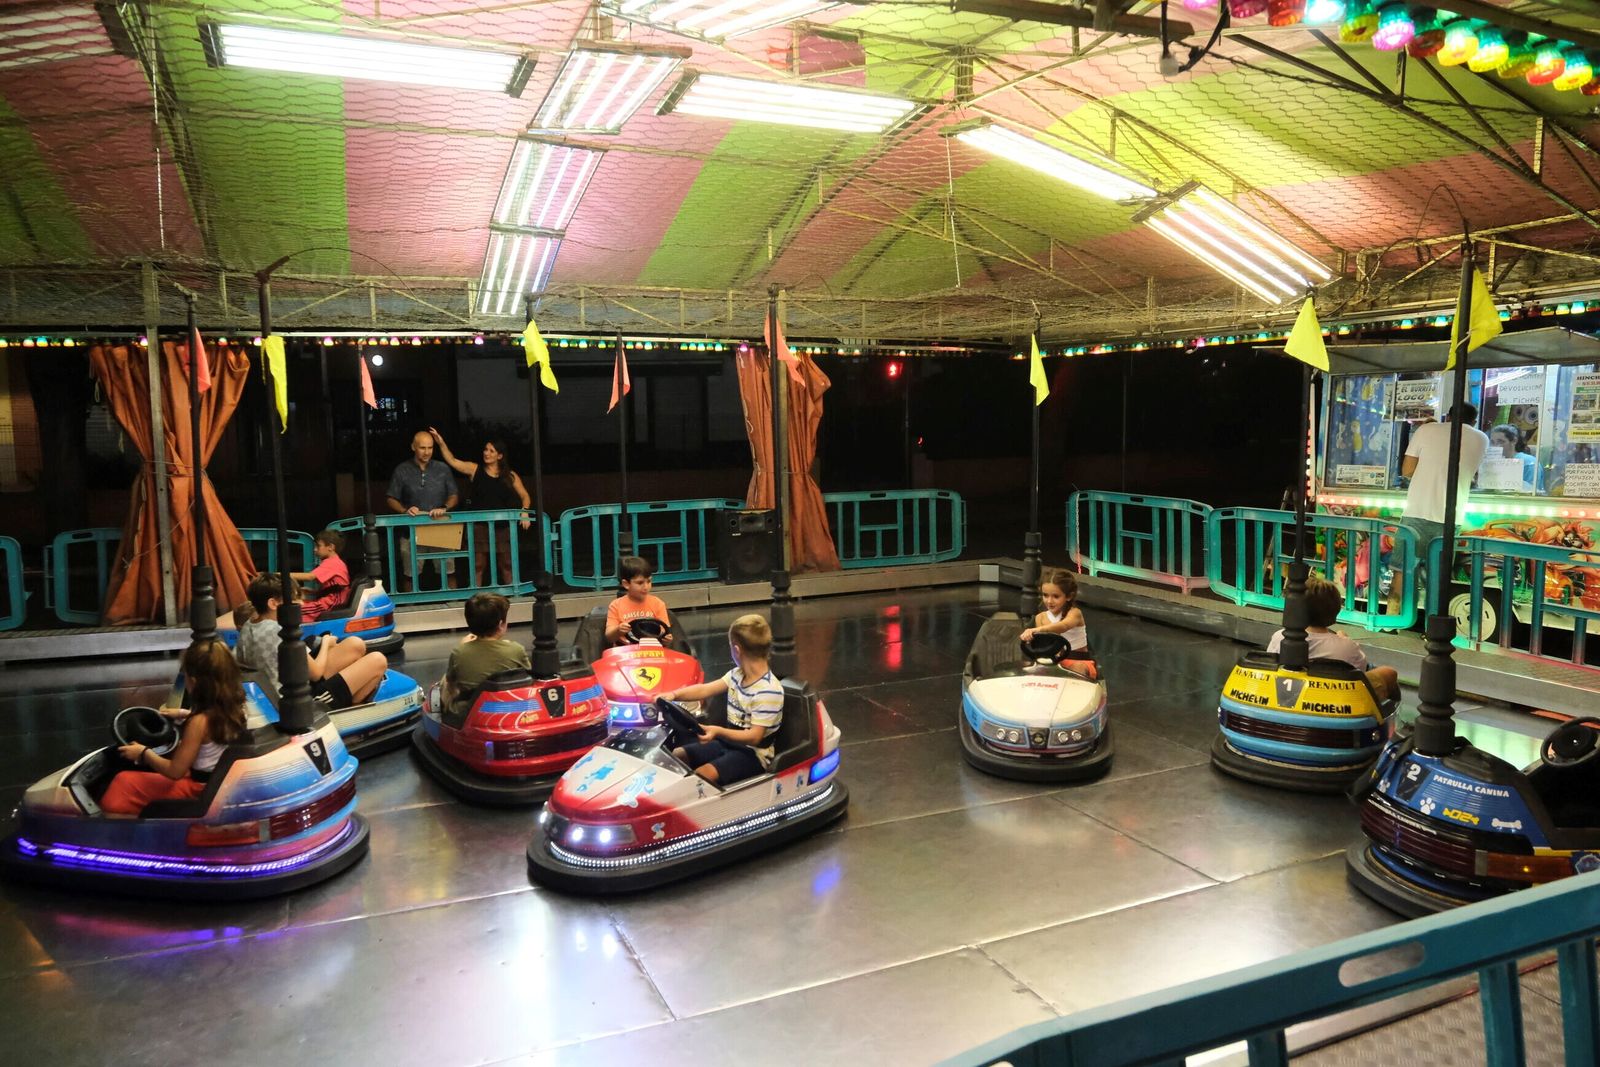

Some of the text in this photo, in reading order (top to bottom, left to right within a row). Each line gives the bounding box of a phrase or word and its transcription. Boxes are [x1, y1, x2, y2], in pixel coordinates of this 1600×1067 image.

[1235, 668, 1271, 682] RENAULT
[1282, 678, 1293, 692] 1
[1308, 680, 1357, 690] RENAULT
[547, 688, 559, 702] 6
[1230, 688, 1269, 706] MICHELIN
[1301, 701, 1352, 714] MICHELIN
[310, 741, 322, 757] 9
[1406, 763, 1422, 782] 2
[1433, 774, 1510, 798] PATRULLA CANINA
